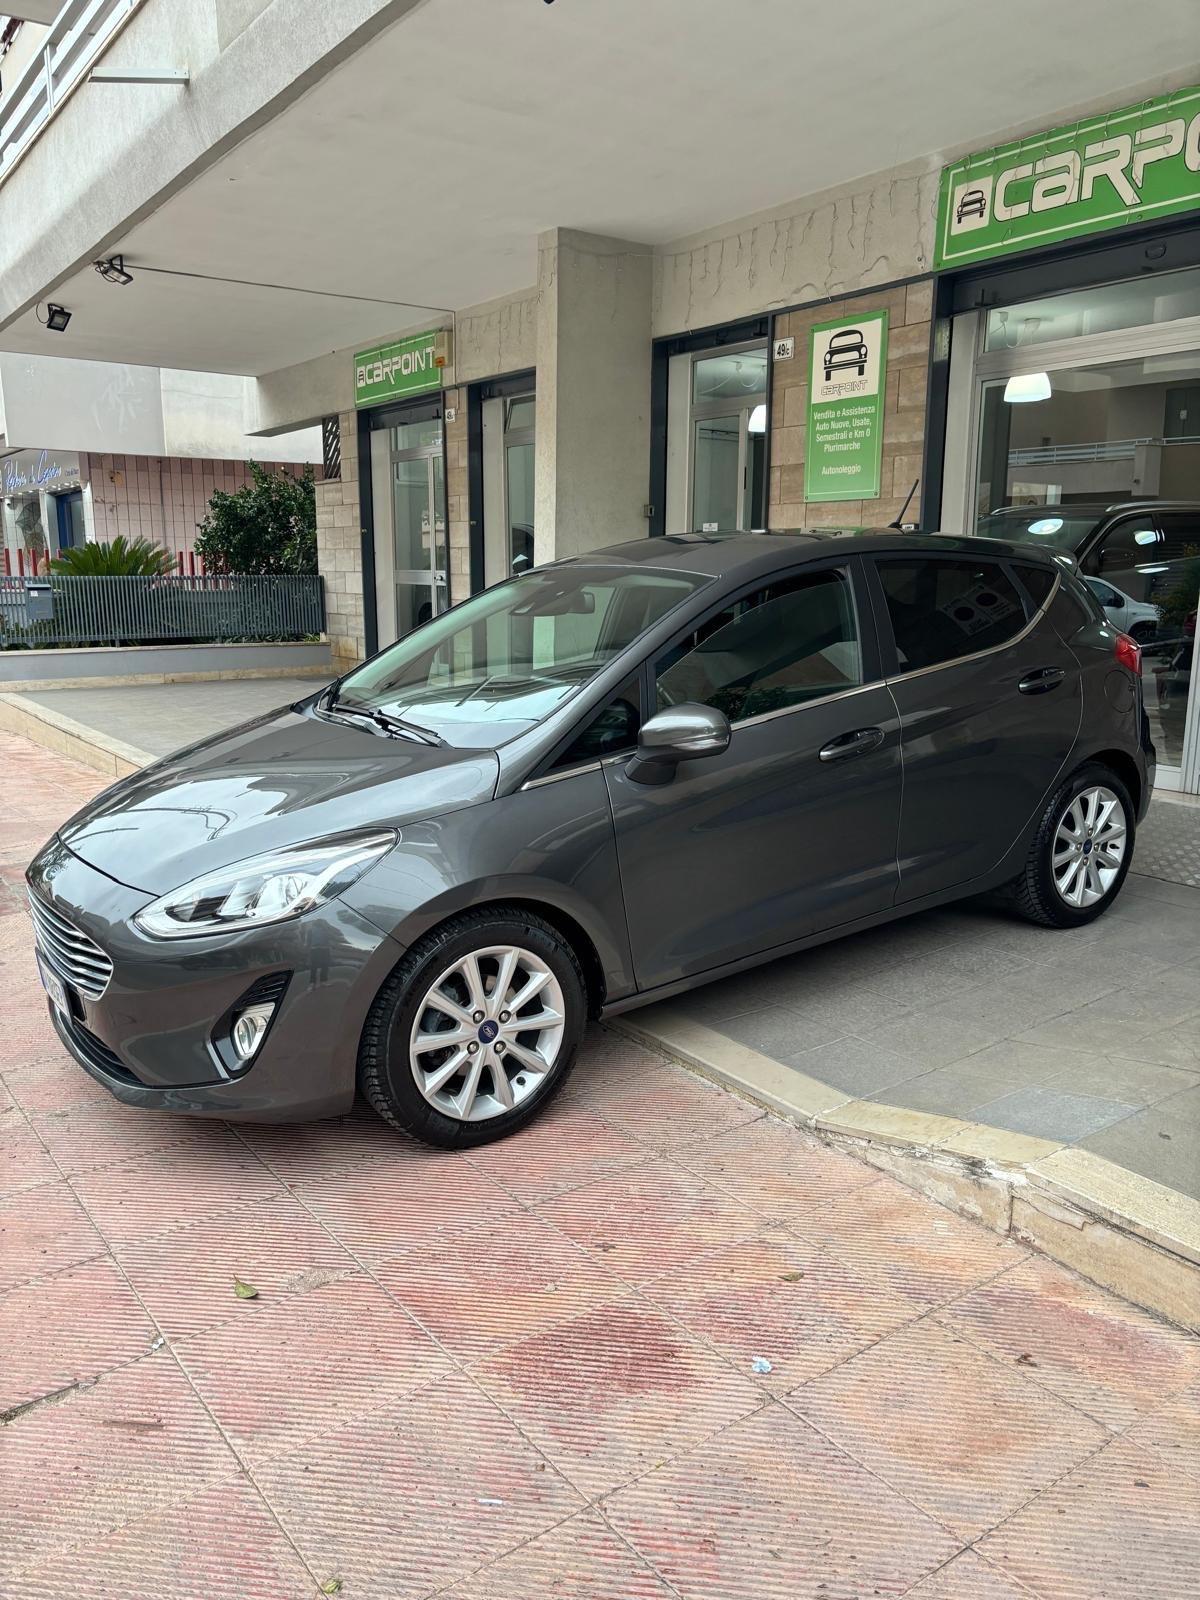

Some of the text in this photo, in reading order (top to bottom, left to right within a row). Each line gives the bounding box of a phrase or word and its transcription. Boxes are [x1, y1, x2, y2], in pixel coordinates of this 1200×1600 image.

[366, 346, 435, 385] CARPOINT
[820, 379, 868, 396] CARPOINT
[813, 405, 876, 421] Vendita e Assistenza
[815, 417, 872, 431] Auto Nuove, Usate,
[816, 428, 871, 442] Semestrali e Km 0
[823, 441, 861, 452] Plurimarche
[821, 463, 861, 475] Autonoleggio
